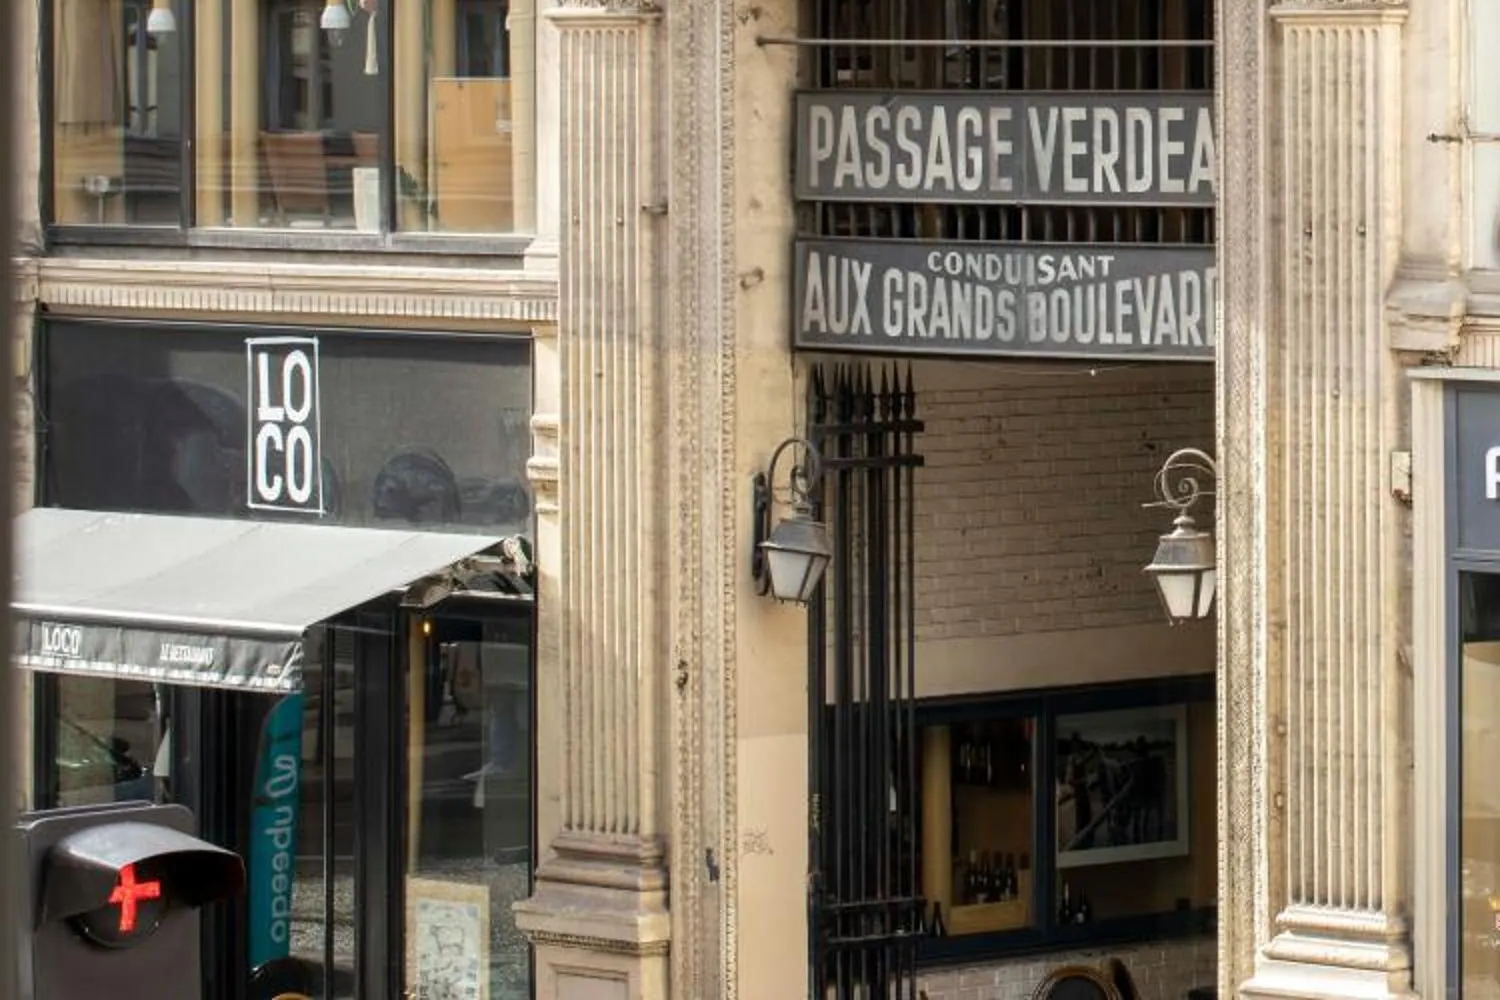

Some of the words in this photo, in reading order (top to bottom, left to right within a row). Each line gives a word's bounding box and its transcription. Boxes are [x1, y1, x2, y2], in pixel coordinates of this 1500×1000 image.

[808, 104, 1014, 191] PASSAGE
[1027, 106, 1217, 193] VERDEA
[802, 251, 873, 336] AUX
[882, 267, 1017, 342] GRANDS
[926, 250, 1115, 287] CONDUISANT
[43, 625, 81, 654] LOCO
